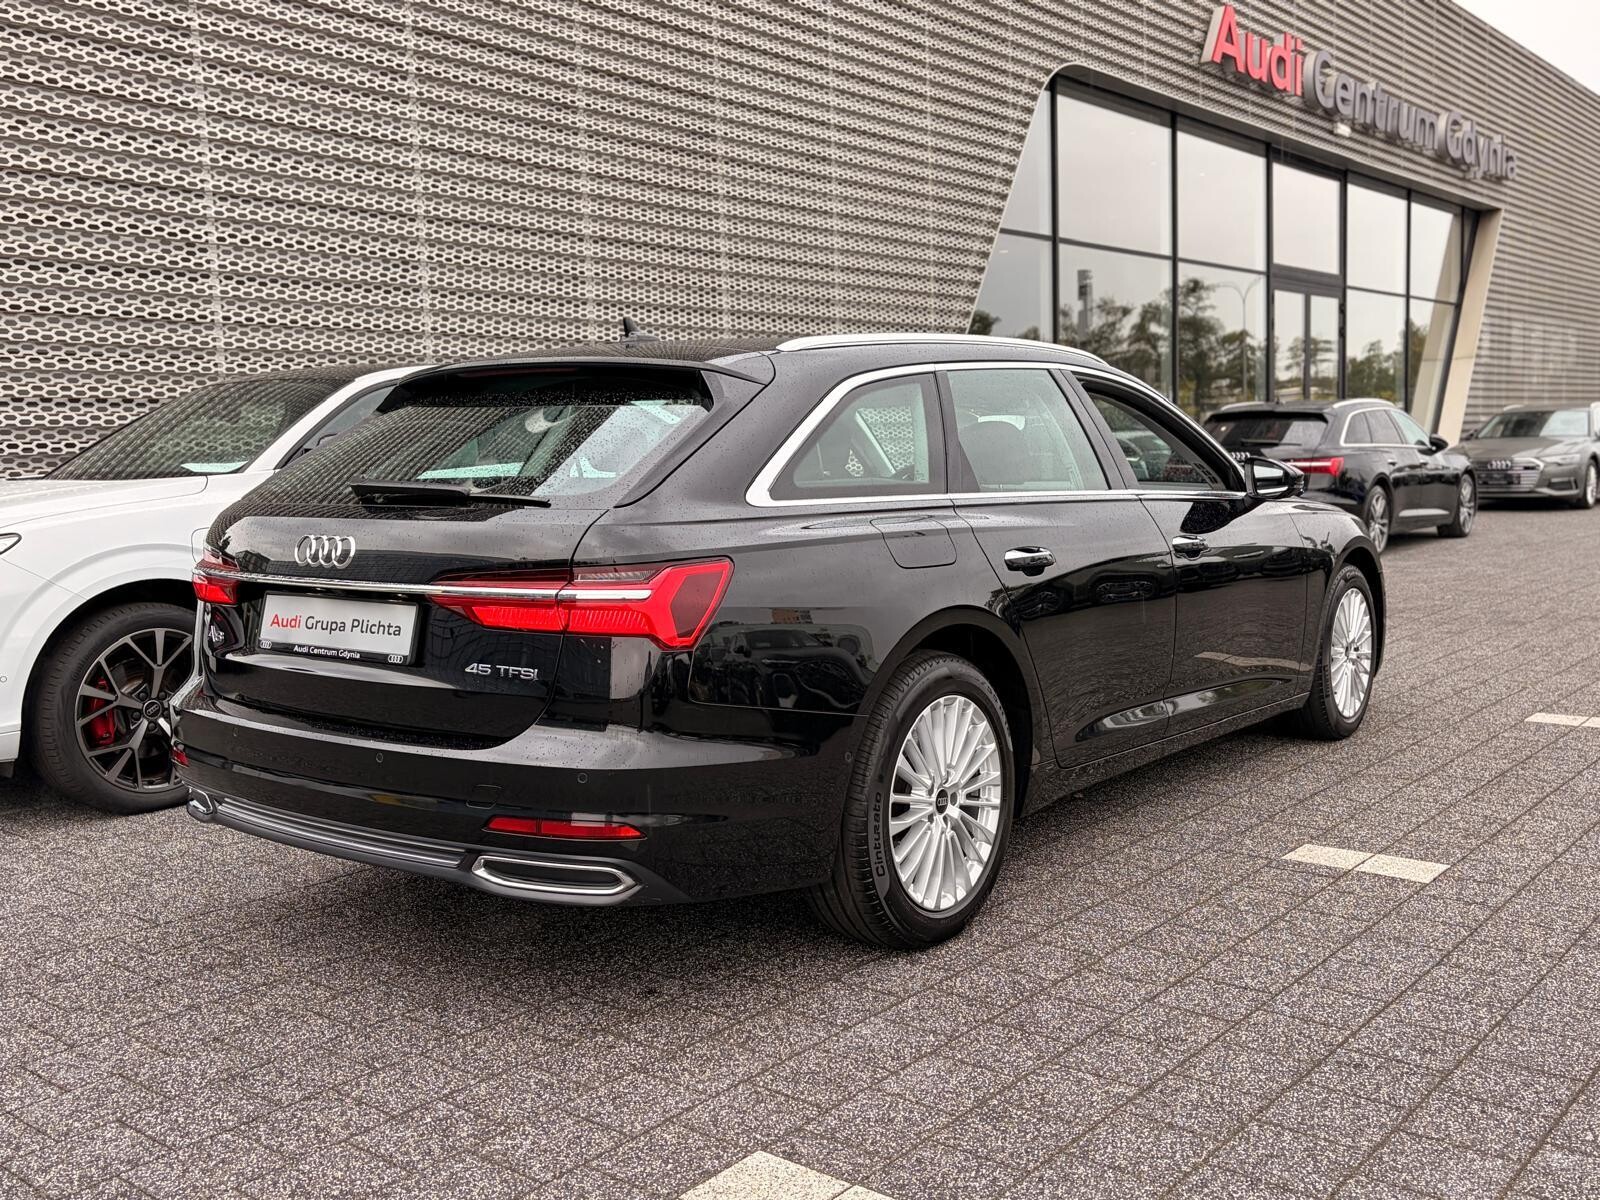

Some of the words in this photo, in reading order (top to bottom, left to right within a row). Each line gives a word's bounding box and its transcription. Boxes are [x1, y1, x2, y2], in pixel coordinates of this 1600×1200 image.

[1202, 4, 1304, 97] Audi
[1303, 50, 1439, 151] Centrum
[1437, 110, 1517, 181] Gdynia
[270, 613, 302, 630] Audi
[304, 615, 346, 635] Grupa
[350, 618, 402, 637] Plichta
[293, 645, 309, 654] Audi
[309, 646, 338, 657] Centrum
[338, 649, 361, 660] Gdynia
[464, 662, 492, 676] 45
[495, 664, 540, 682] TFSI
[872, 791, 886, 878] Cinturato
